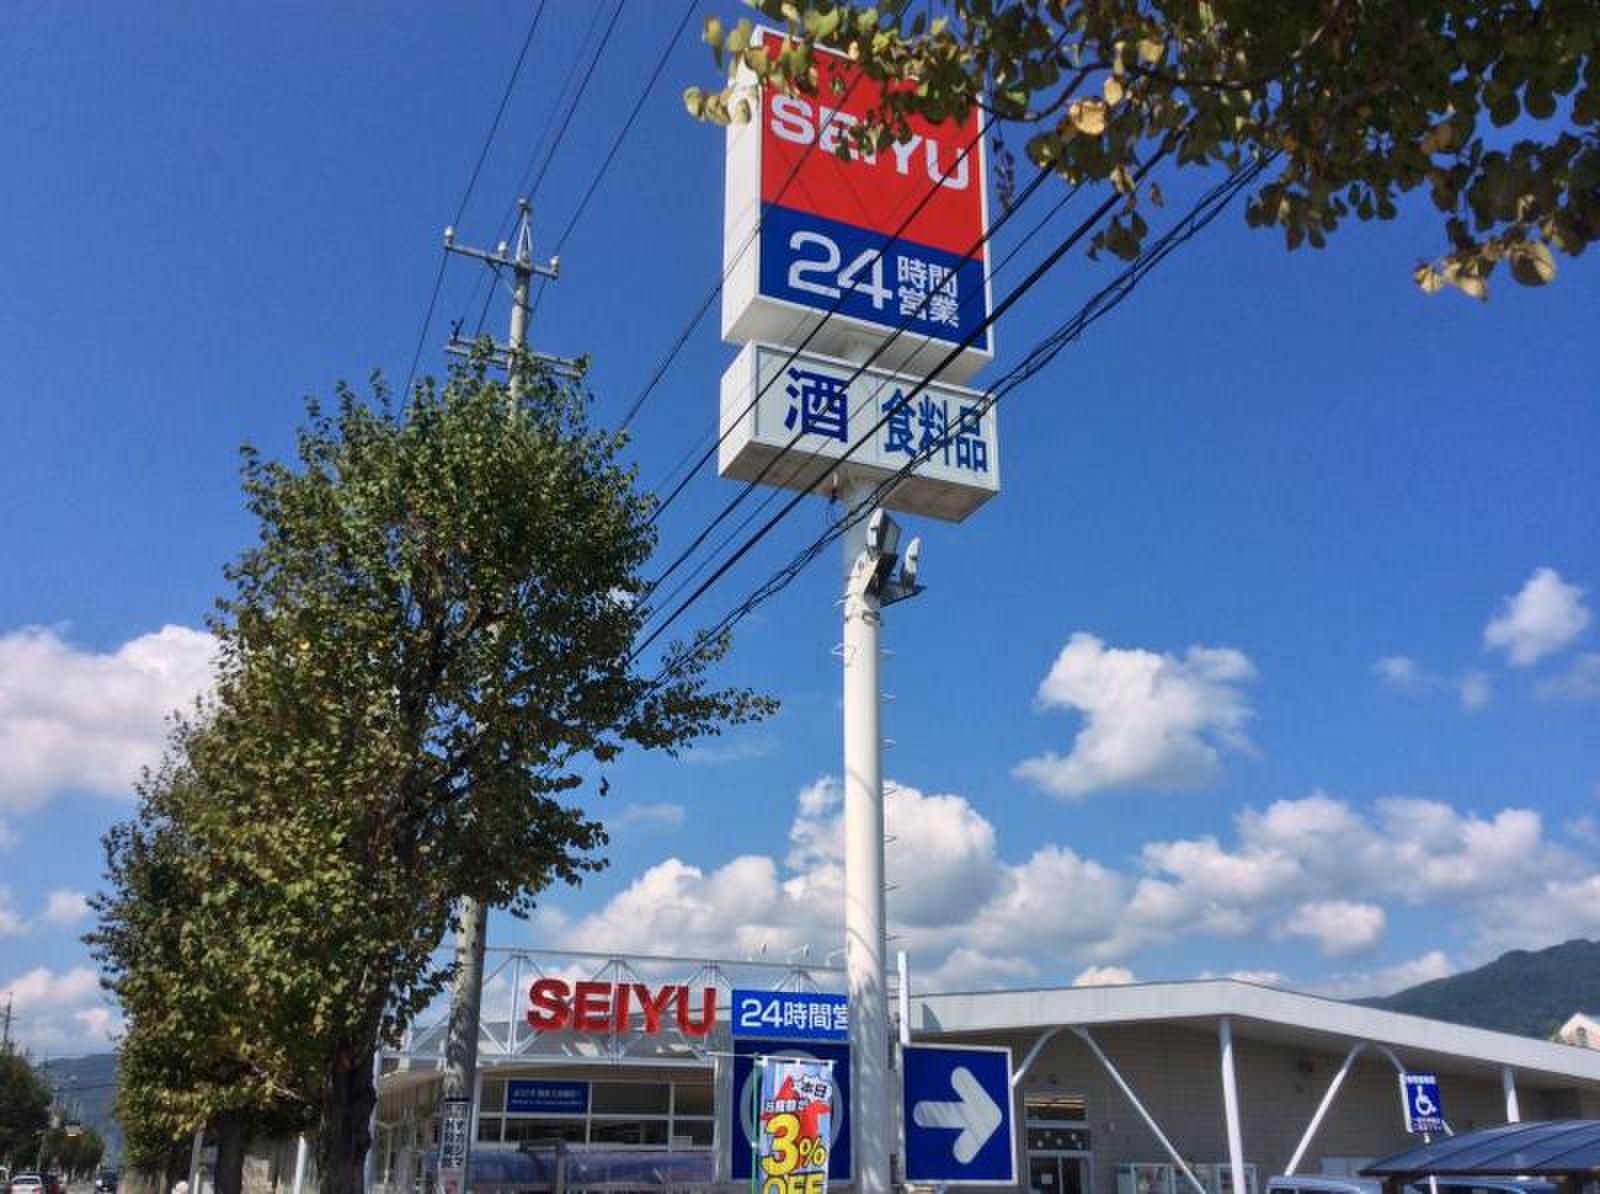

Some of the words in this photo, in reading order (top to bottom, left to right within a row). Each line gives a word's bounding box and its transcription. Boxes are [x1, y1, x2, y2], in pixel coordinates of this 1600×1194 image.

[788, 231, 893, 310] 24
[897, 255, 958, 298] 時間
[898, 285, 960, 328] 営業
[784, 367, 848, 443] 酒
[881, 388, 987, 472] 食料品
[528, 978, 716, 1039] SEIYU
[761, 1113, 825, 1176] 3%
